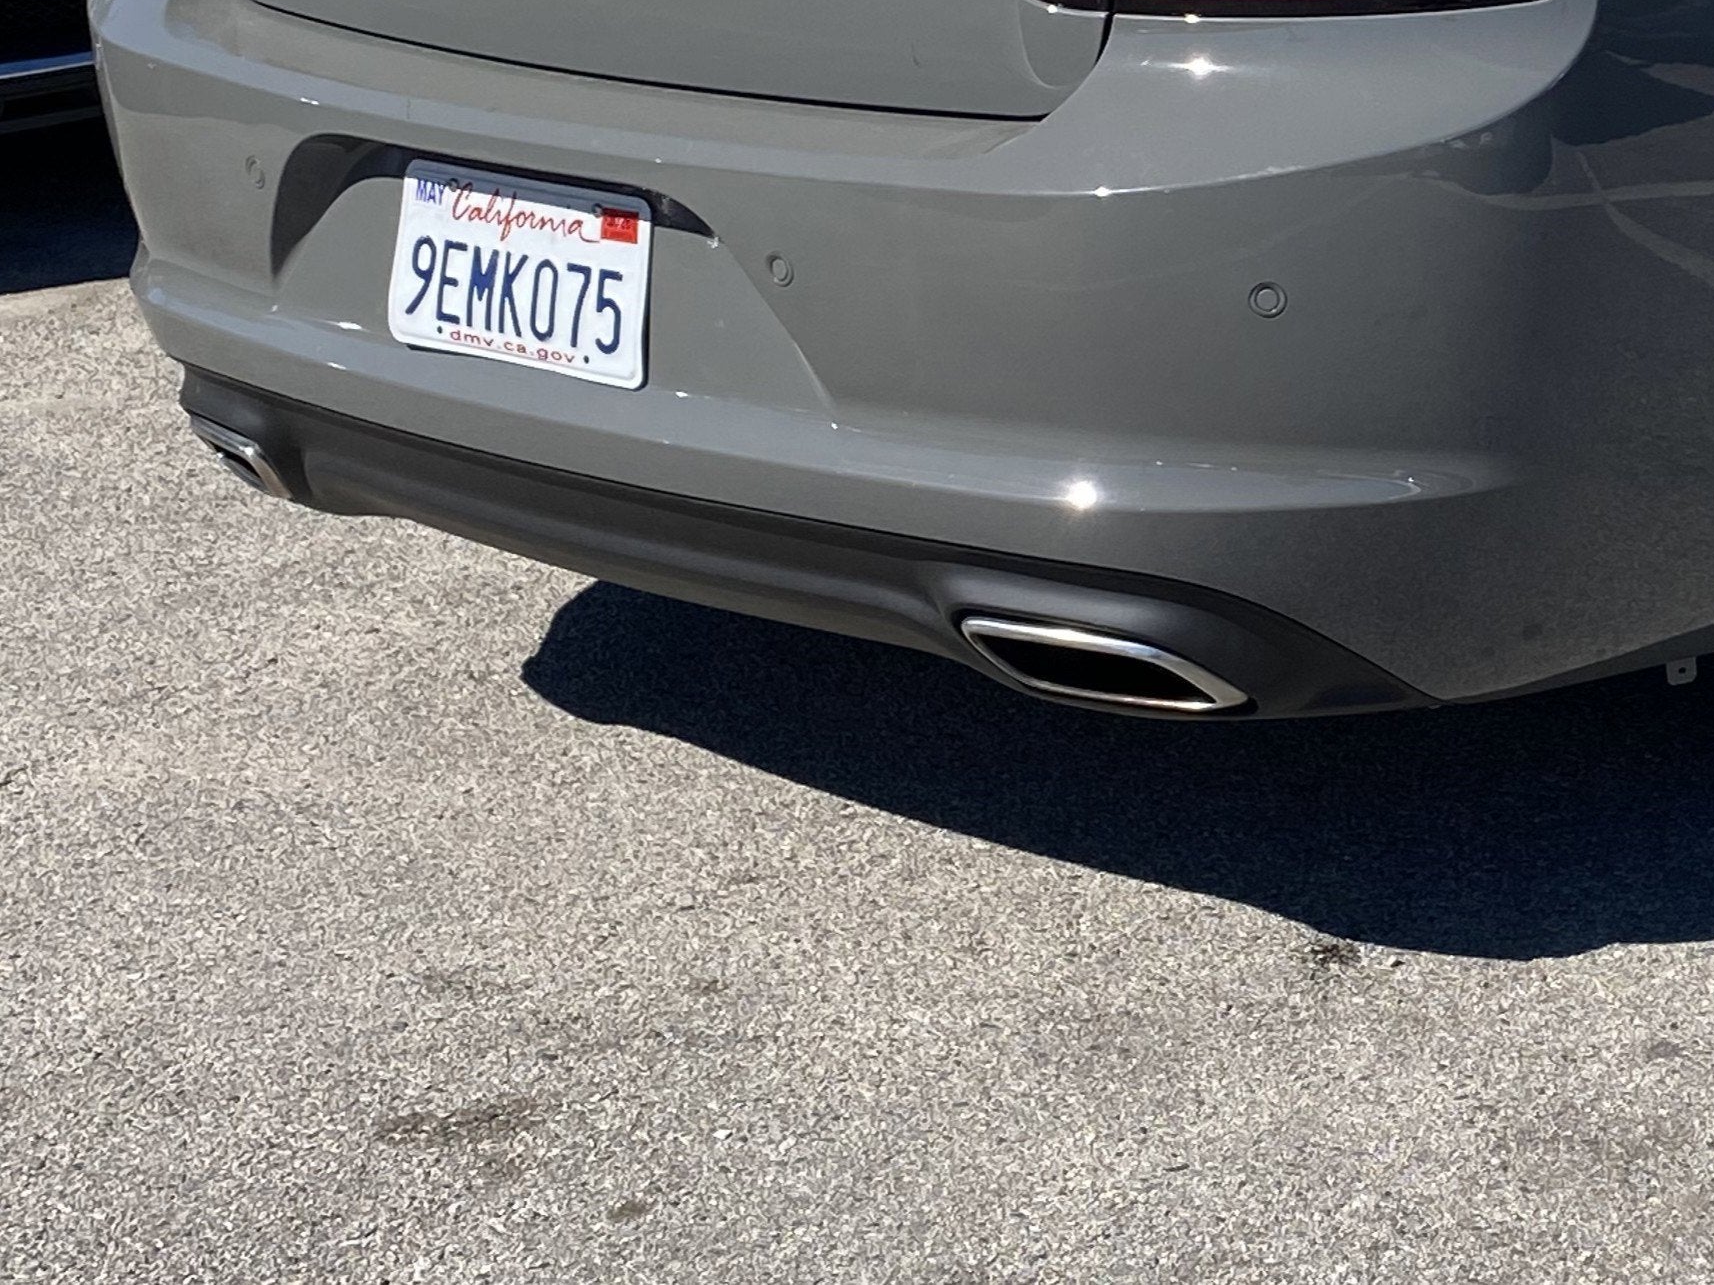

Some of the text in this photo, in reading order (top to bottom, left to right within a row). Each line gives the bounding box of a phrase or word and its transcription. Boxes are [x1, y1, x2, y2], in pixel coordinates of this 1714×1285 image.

[451, 181, 600, 243] California
[404, 234, 624, 355] 9EMK075
[449, 328, 576, 364] dmv.ca.gov
